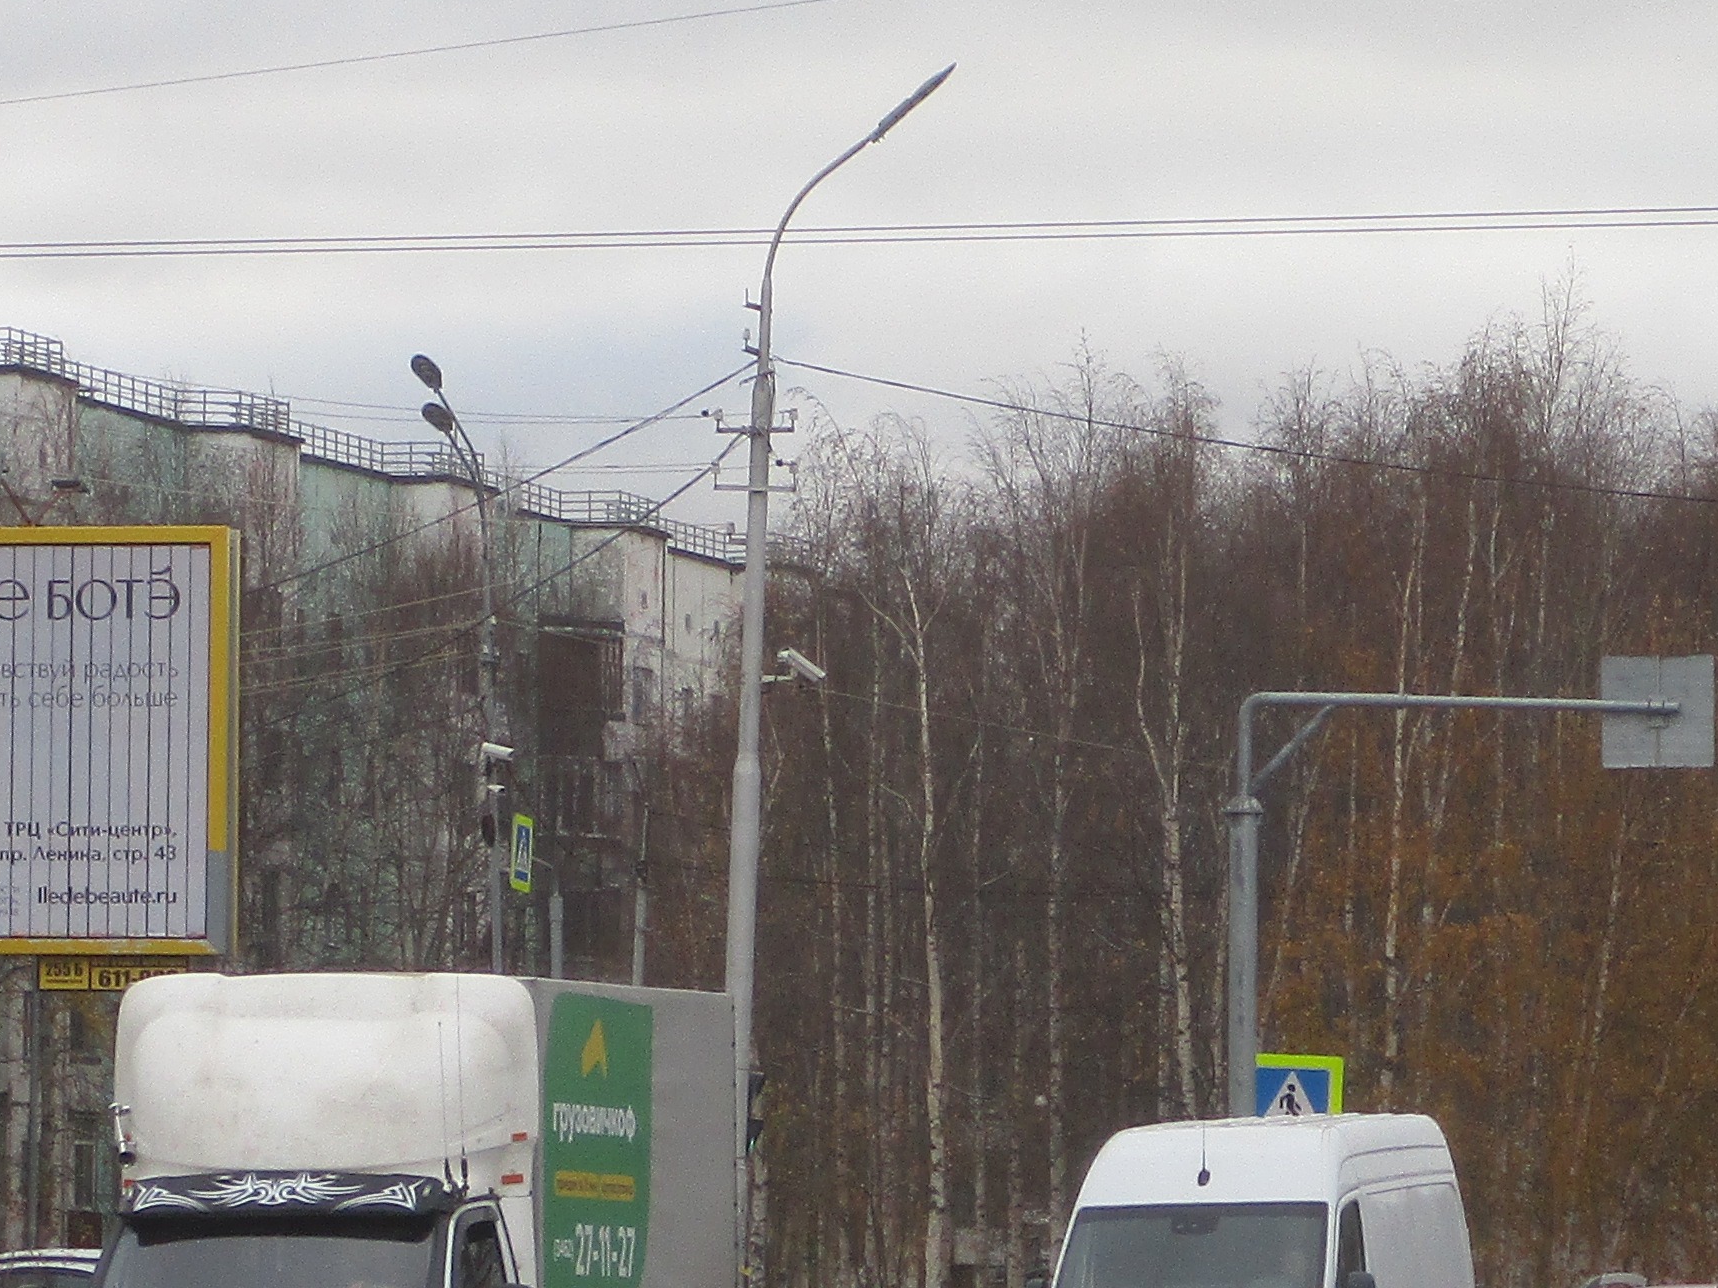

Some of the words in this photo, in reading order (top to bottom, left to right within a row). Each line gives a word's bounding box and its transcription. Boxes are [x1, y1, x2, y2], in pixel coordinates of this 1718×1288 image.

[84, 660, 178, 680] радость
[28, 686, 83, 709] себе
[91, 685, 178, 709] больше
[4, 820, 41, 839] ТРЦ
[0, 848, 27, 865] пр.
[113, 847, 147, 864] стр.
[153, 844, 177, 861] 43
[552, 1101, 636, 1144] грузовичкоф
[574, 1222, 636, 1278] 27-11-27
